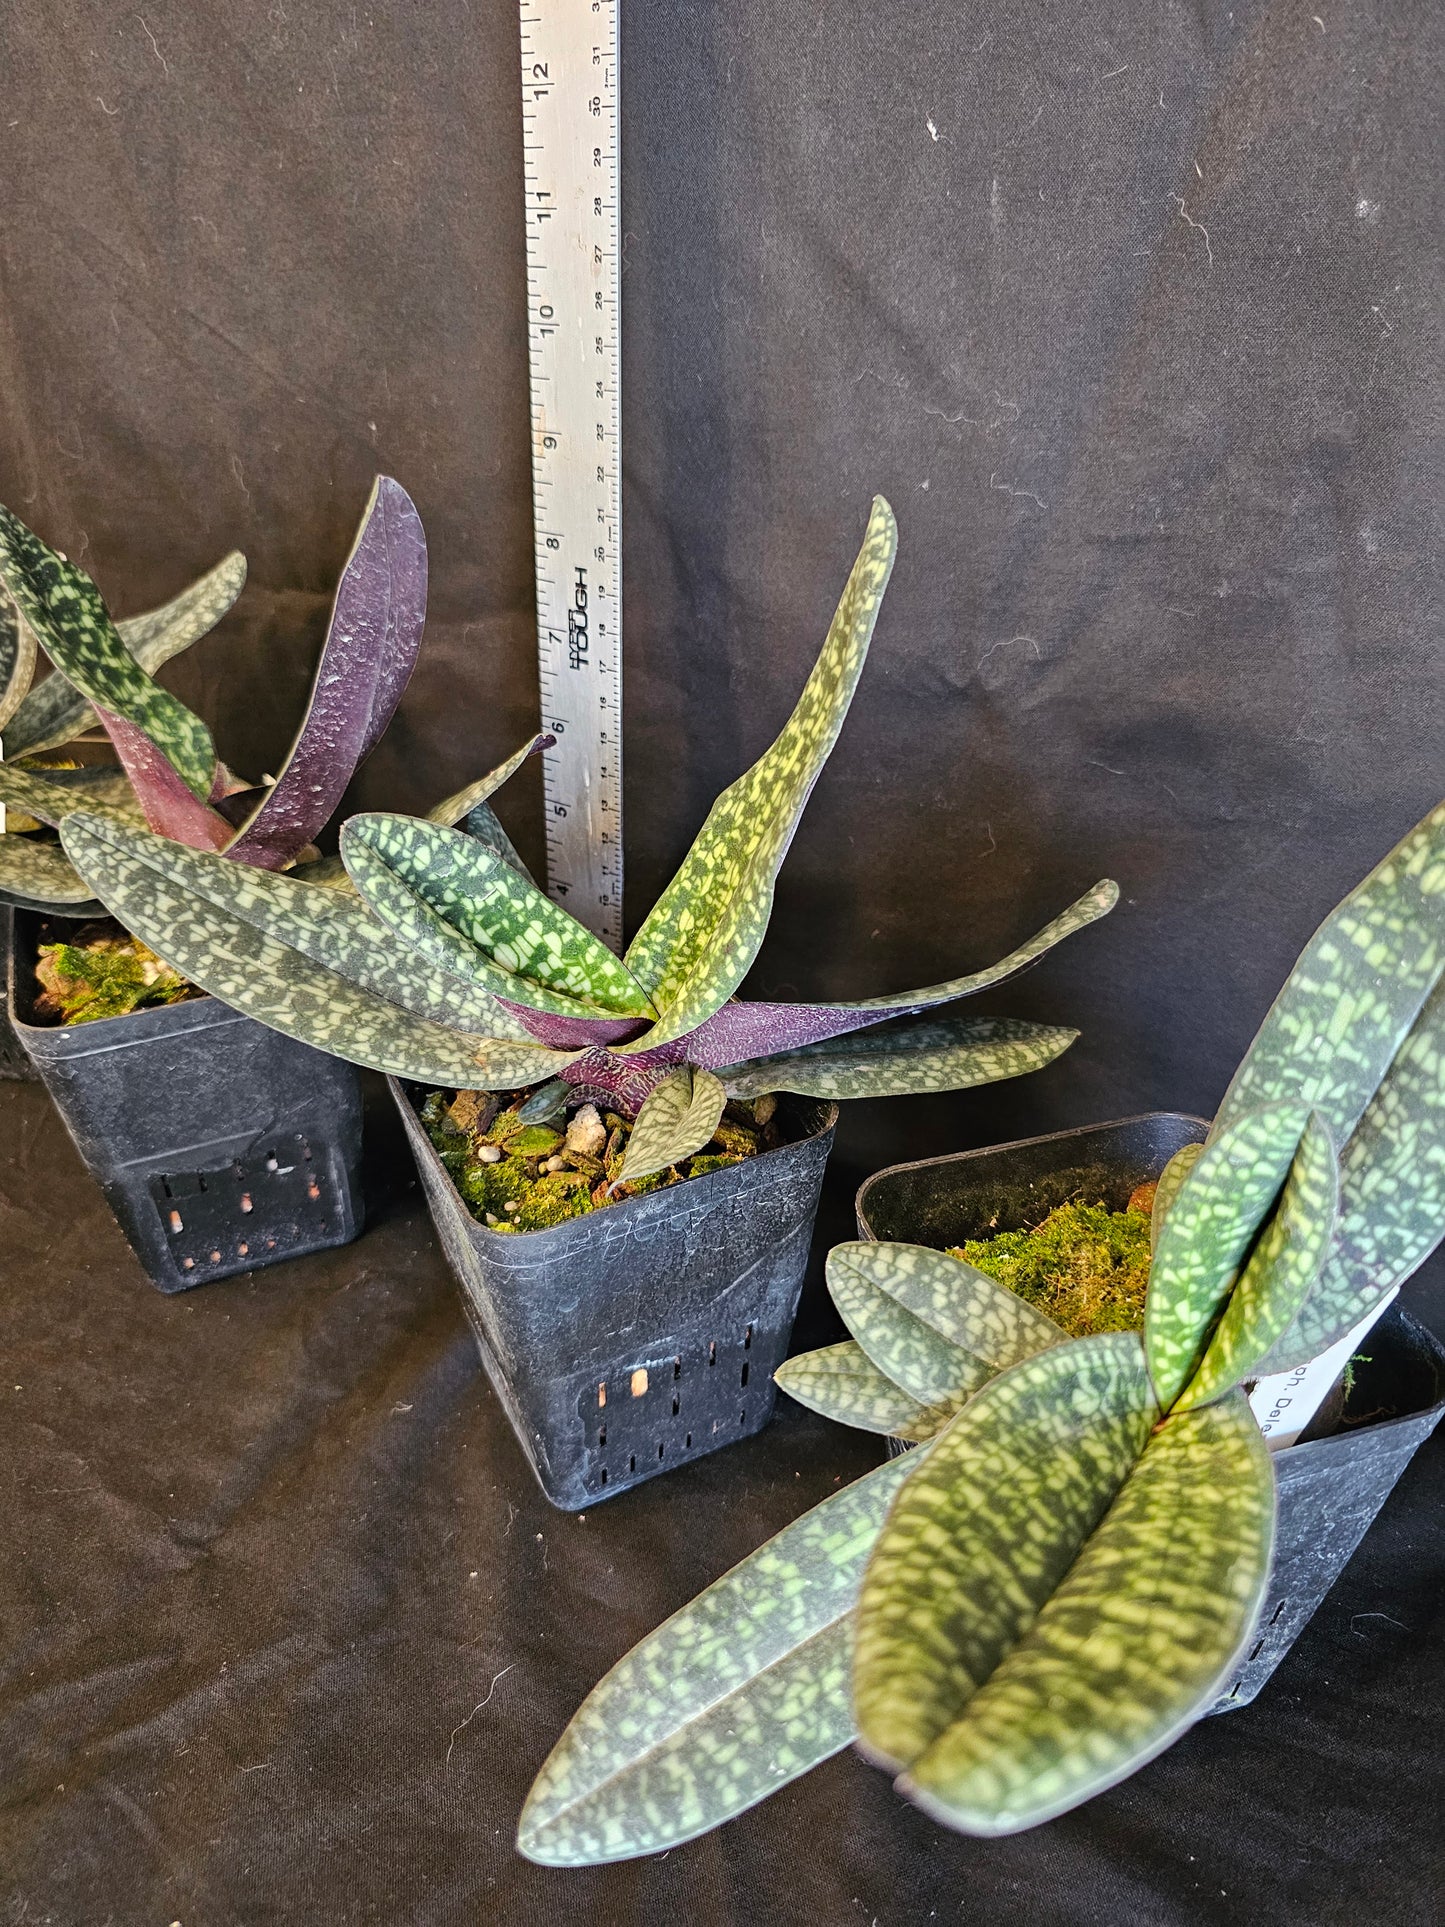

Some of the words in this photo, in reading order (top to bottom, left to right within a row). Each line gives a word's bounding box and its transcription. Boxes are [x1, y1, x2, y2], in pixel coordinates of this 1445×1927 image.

[592, 47, 600, 65] 31
[533, 63, 548, 100] 12
[593, 96, 601, 117] 30
[593, 148, 601, 167] 29
[536, 192, 551, 223] 11
[594, 197, 602, 216] 28
[594, 245, 602, 264] 27
[595, 291, 603, 311] 26
[539, 305, 554, 338] 10
[595, 337, 603, 355] 25
[596, 381, 603, 399] 24
[596, 424, 604, 442] 23
[543, 436, 557, 450] 9
[597, 466, 604, 483] 22
[597, 508, 605, 523] 21
[546, 538, 560, 551] 8
[598, 546, 605, 563] 20
[598, 585, 606, 600] 19
[575, 567, 589, 665] TOUGH
[549, 631, 562, 644] 7
[599, 624, 606, 638] 18
[599, 660, 606, 674] 17
[600, 696, 607, 710] 16
[552, 722, 565, 733] 6
[600, 731, 607, 745] 15
[600, 766, 607, 779] 14
[554, 805, 567, 818] 5
[601, 800, 608, 812] 13
[556, 884, 568, 896] 4
